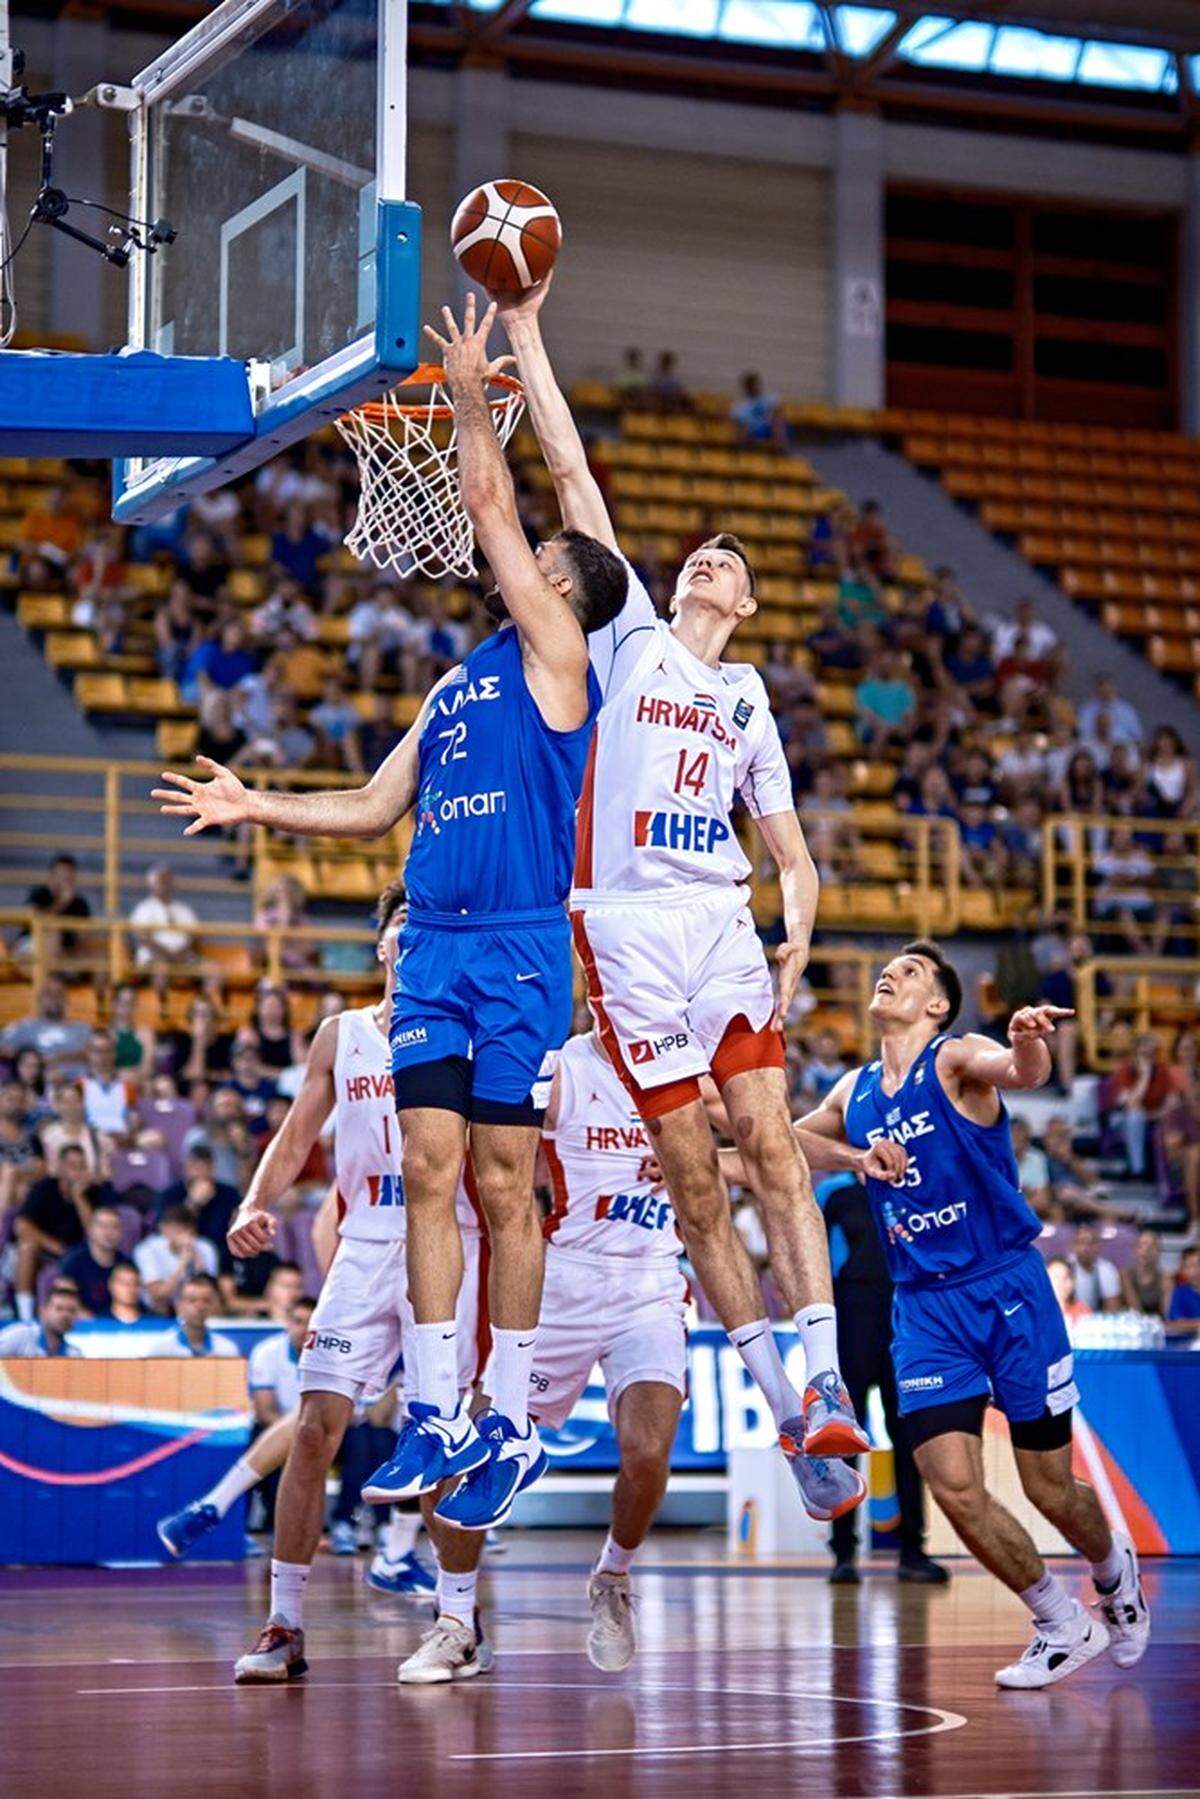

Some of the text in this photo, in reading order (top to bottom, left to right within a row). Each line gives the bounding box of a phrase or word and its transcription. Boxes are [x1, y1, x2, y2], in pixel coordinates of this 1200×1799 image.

[636, 695, 736, 751] HRVATS
[438, 721, 467, 765] 72
[674, 749, 709, 797] 14
[669, 812, 730, 854] HEP
[653, 1033, 689, 1055] HPB
[346, 1074, 396, 1102] HRVA
[382, 1115, 392, 1155] 1
[586, 1126, 649, 1150] HRVA
[316, 1333, 352, 1354] HPB
[529, 1371, 550, 1393] PB
